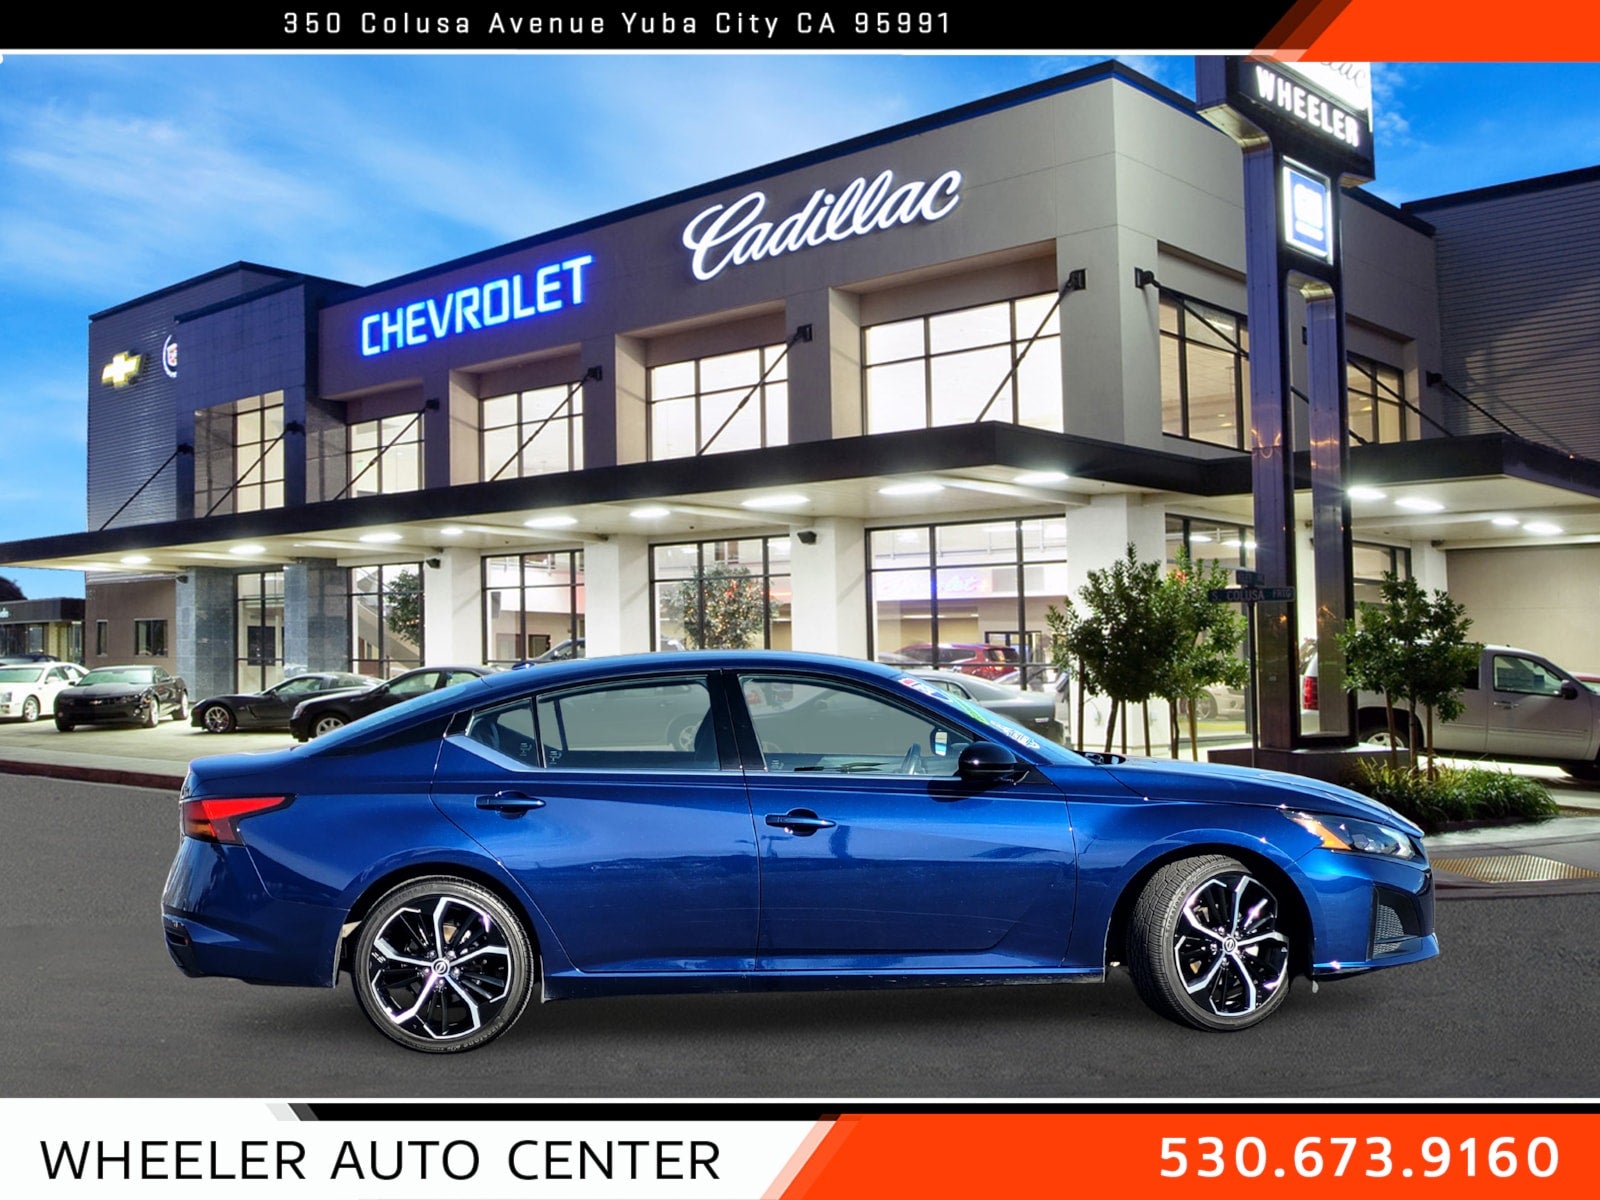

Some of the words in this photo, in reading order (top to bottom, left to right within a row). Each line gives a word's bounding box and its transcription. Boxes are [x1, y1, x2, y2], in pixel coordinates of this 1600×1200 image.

[1255, 66, 1360, 148] WHEELER
[682, 169, 962, 280] Cadillac
[361, 255, 594, 357] CHEVROLET
[1226, 589, 1265, 601] COLUSA
